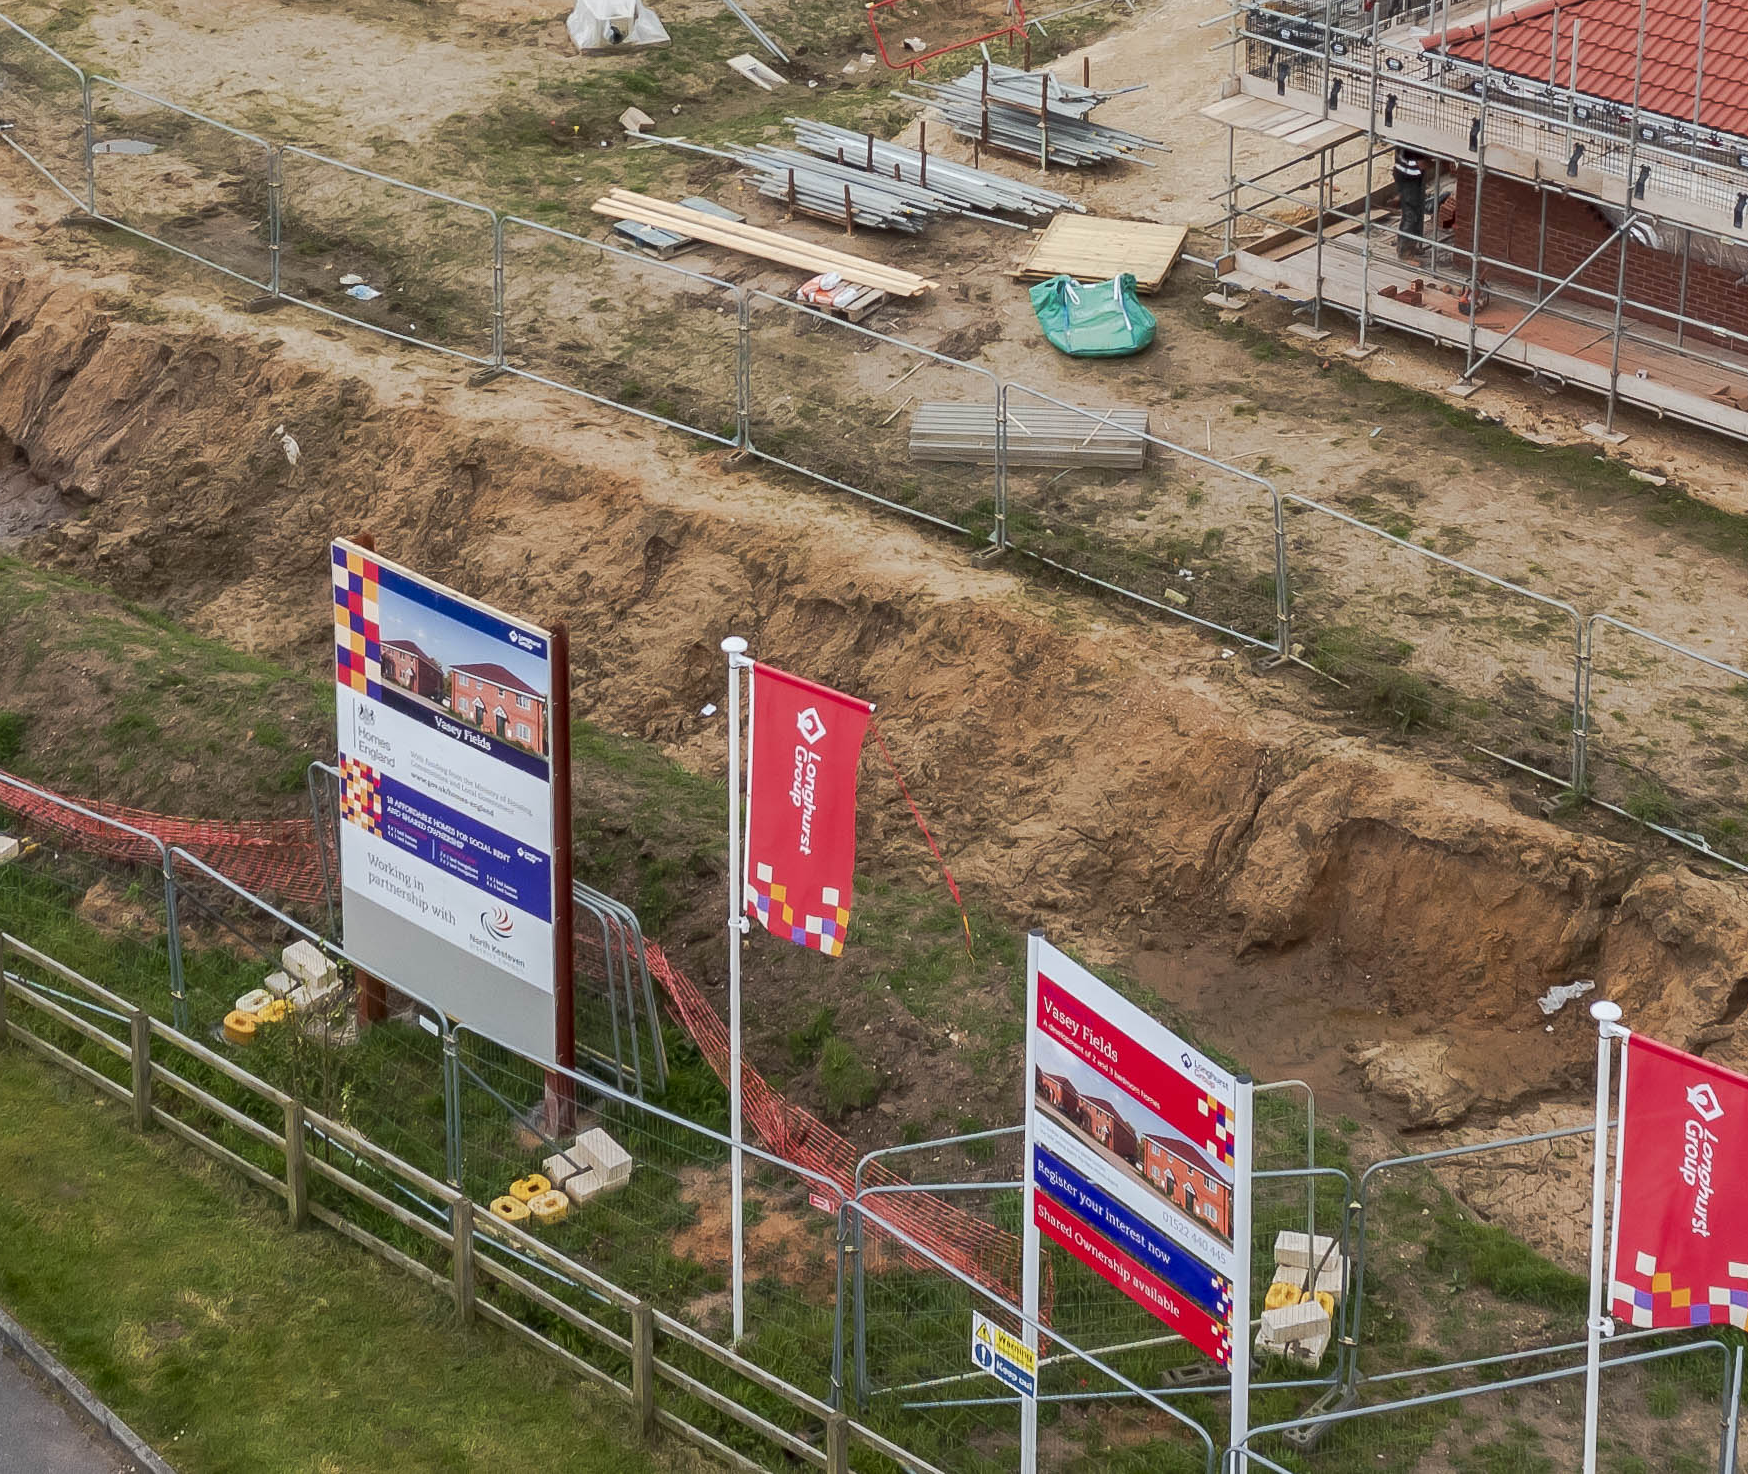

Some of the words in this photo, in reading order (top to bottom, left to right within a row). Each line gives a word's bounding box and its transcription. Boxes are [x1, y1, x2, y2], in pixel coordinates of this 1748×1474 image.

[358, 725, 392, 753] Homes
[358, 741, 396, 769] England
[434, 715, 462, 739] Vasey
[464, 730, 491, 751] Fields
[789, 745, 808, 807] Group
[799, 751, 822, 856] Longhurst
[456, 829, 469, 842] FOR
[469, 836, 492, 855] SOCIAL
[367, 852, 413, 886] Working
[414, 876, 425, 893] in
[368, 872, 429, 914] partnership
[432, 903, 457, 927] with
[469, 933, 491, 951] North
[491, 944, 525, 969] Kesteven
[1042, 1019, 1048, 1027] A
[1084, 1049, 1092, 1059] of
[1097, 1061, 1109, 1072] and
[1043, 995, 1080, 1036] Vasey
[1082, 1025, 1118, 1063] Fields
[1194, 1059, 1230, 1092] Longhurst
[1194, 1069, 1216, 1090] Group
[1679, 1119, 1704, 1187] Group
[1691, 1128, 1719, 1238] Longhurst
[1037, 1158, 1079, 1198] Register
[1079, 1190, 1105, 1217] your
[1105, 1207, 1146, 1248] interest
[1148, 1241, 1172, 1265] now
[1037, 1204, 1073, 1240] Shared
[1074, 1232, 1131, 1282] Ownership
[1132, 1275, 1180, 1319] available
[1162, 1212, 1190, 1239] 01522
[1209, 1245, 1227, 1265] 445
[996, 1360, 1018, 1382] Keep
[1018, 1377, 1033, 1392] out
